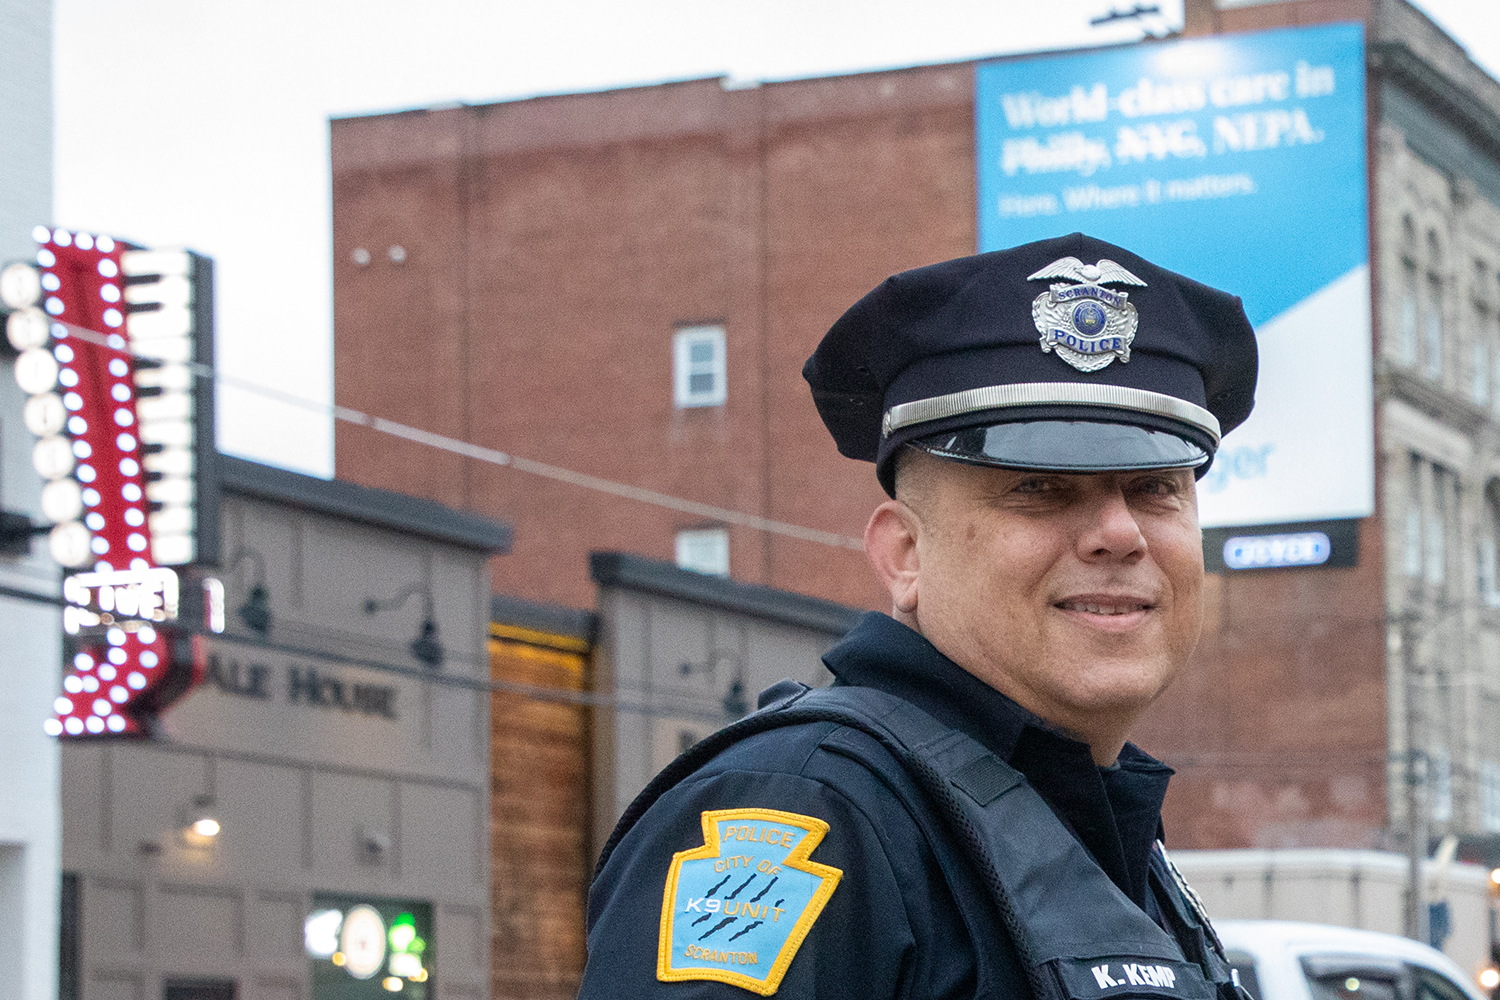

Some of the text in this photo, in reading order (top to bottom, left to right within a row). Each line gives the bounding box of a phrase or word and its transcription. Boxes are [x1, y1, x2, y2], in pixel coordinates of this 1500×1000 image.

[1296, 60, 1335, 98] in
[1058, 287, 1121, 307] SCRANTON
[1054, 330, 1121, 352] POLICE
[723, 826, 796, 849] POLICE
[714, 855, 783, 876] CITY OF
[684, 897, 787, 923] K9 UNIT
[684, 944, 759, 966] SCRANTON
[1091, 964, 1176, 989] K. KEMP
